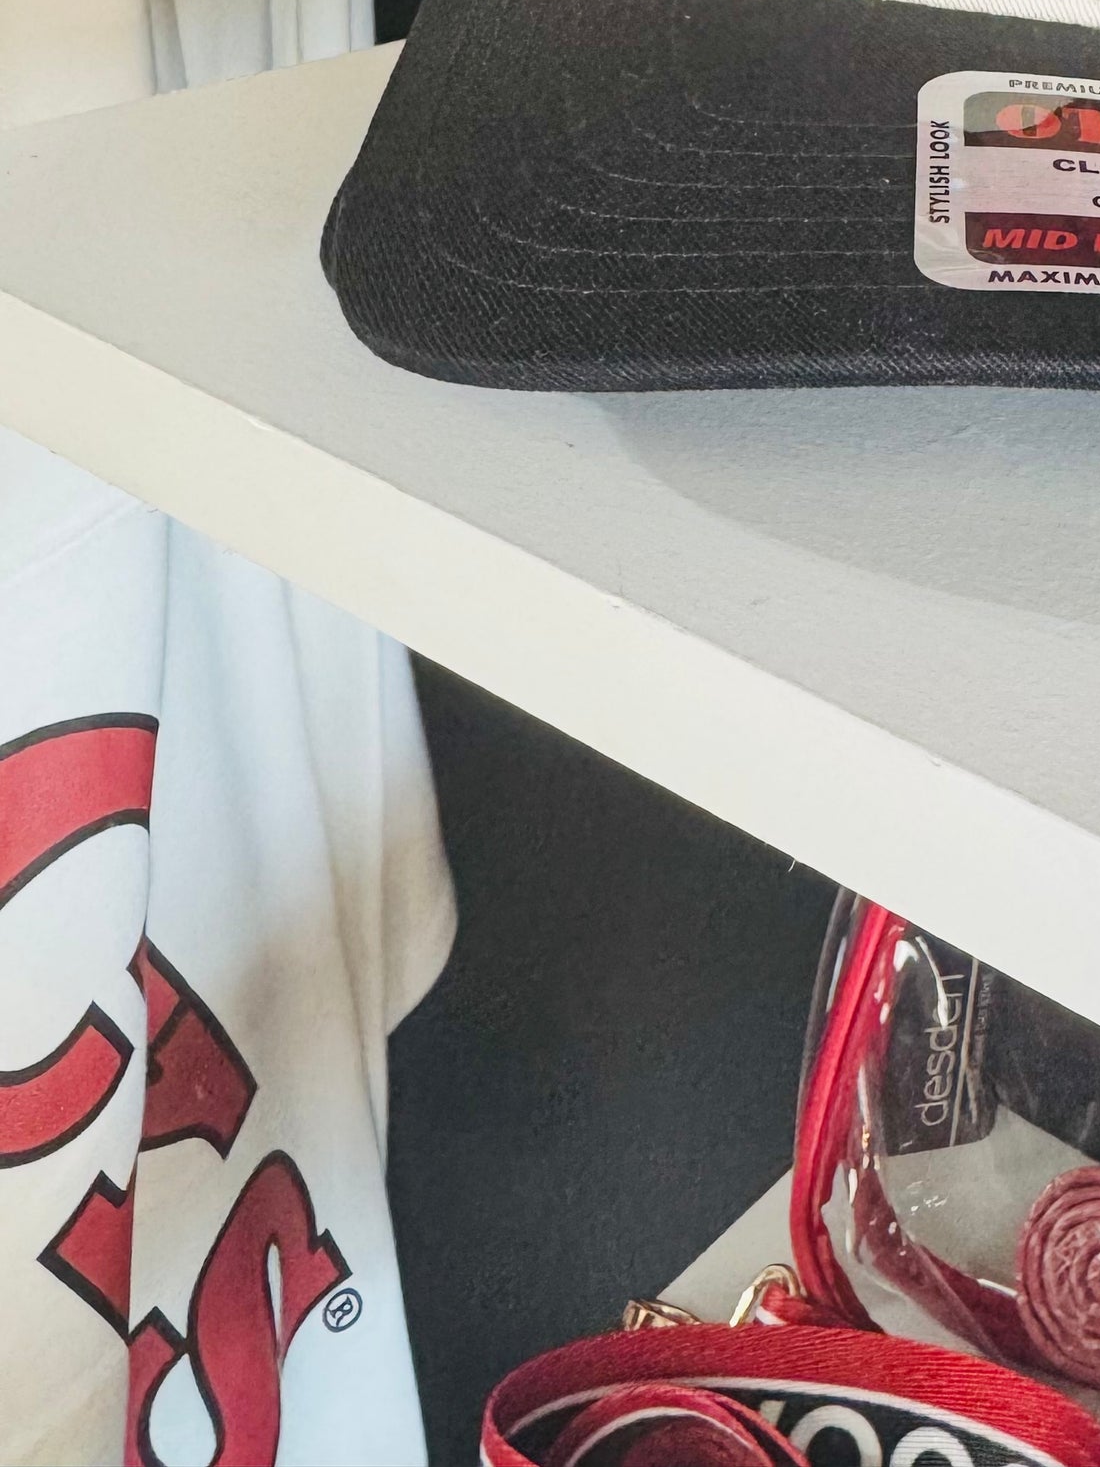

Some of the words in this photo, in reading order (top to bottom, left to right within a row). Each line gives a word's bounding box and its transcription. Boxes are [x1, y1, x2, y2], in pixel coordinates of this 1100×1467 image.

[929, 120, 950, 160] LOOK
[929, 165, 951, 224] STYLISH
[982, 228, 1079, 251] MID
